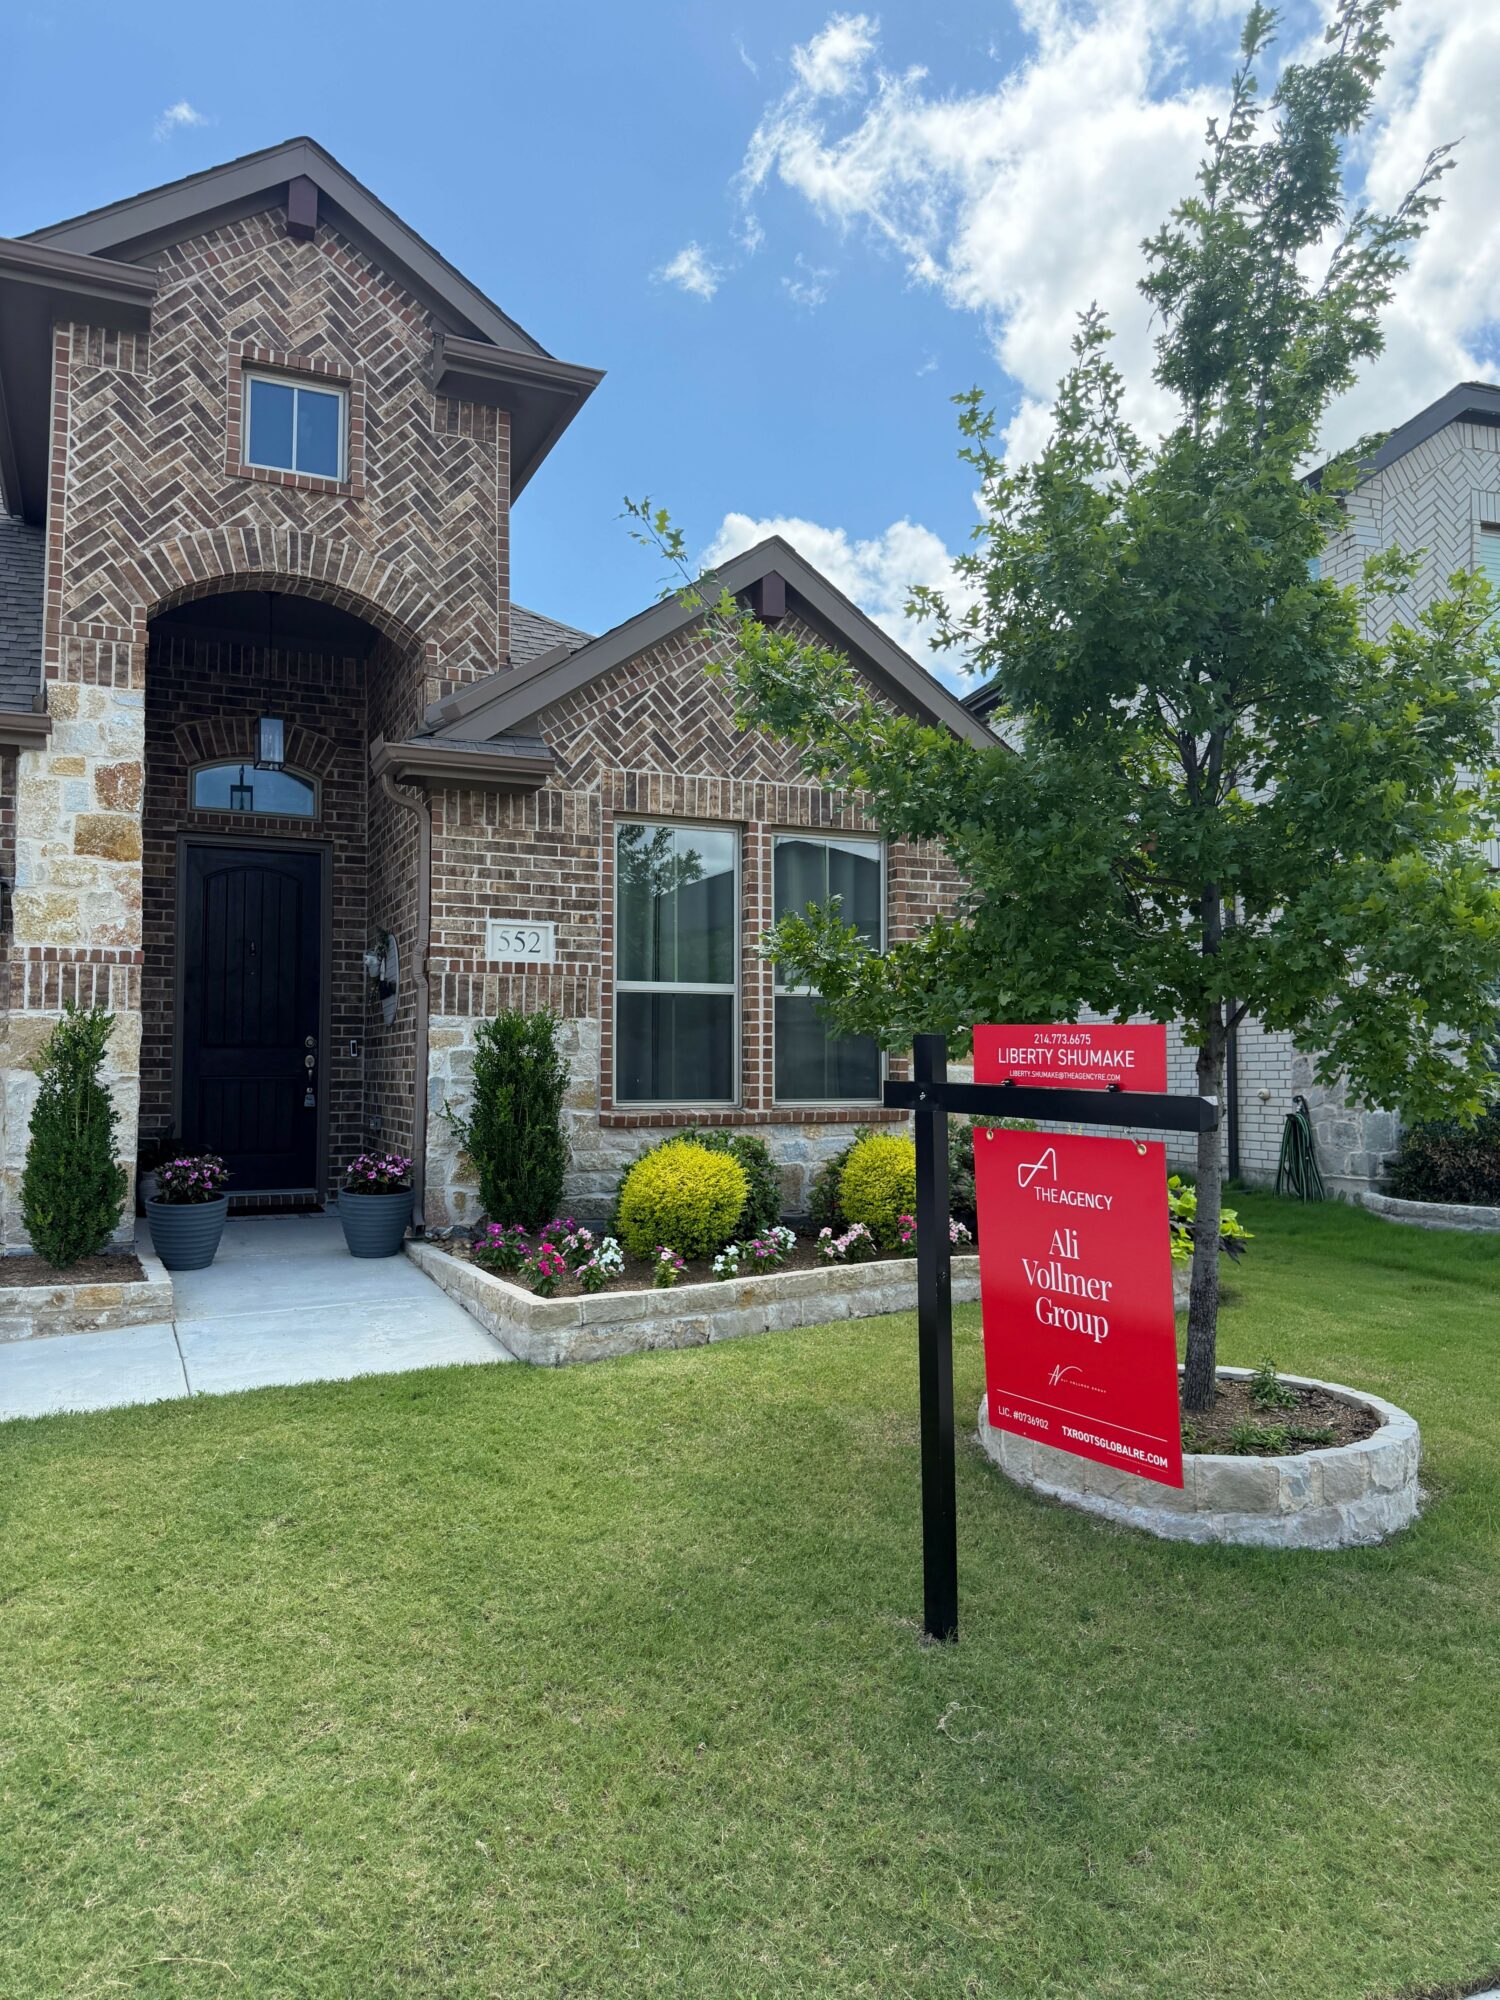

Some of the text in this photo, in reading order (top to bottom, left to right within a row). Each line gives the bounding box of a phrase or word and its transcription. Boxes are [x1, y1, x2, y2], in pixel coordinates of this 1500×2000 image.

[498, 930, 541, 953] 552
[1034, 1033, 1091, 1045] 214.773.6675
[998, 1048, 1135, 1068] LIBERTY SHUMAKE
[1009, 1070, 1121, 1082] LIBERTY.SHUMAKE@THEAGENCYRE.COM
[1048, 1228, 1080, 1260] Ali
[1021, 1258, 1113, 1302] Vollmer
[1035, 1296, 1109, 1343] Group
[998, 1405, 1049, 1430] LIC. #0736902
[1062, 1426, 1168, 1468] TXROOTSGLOBALRE.COM
